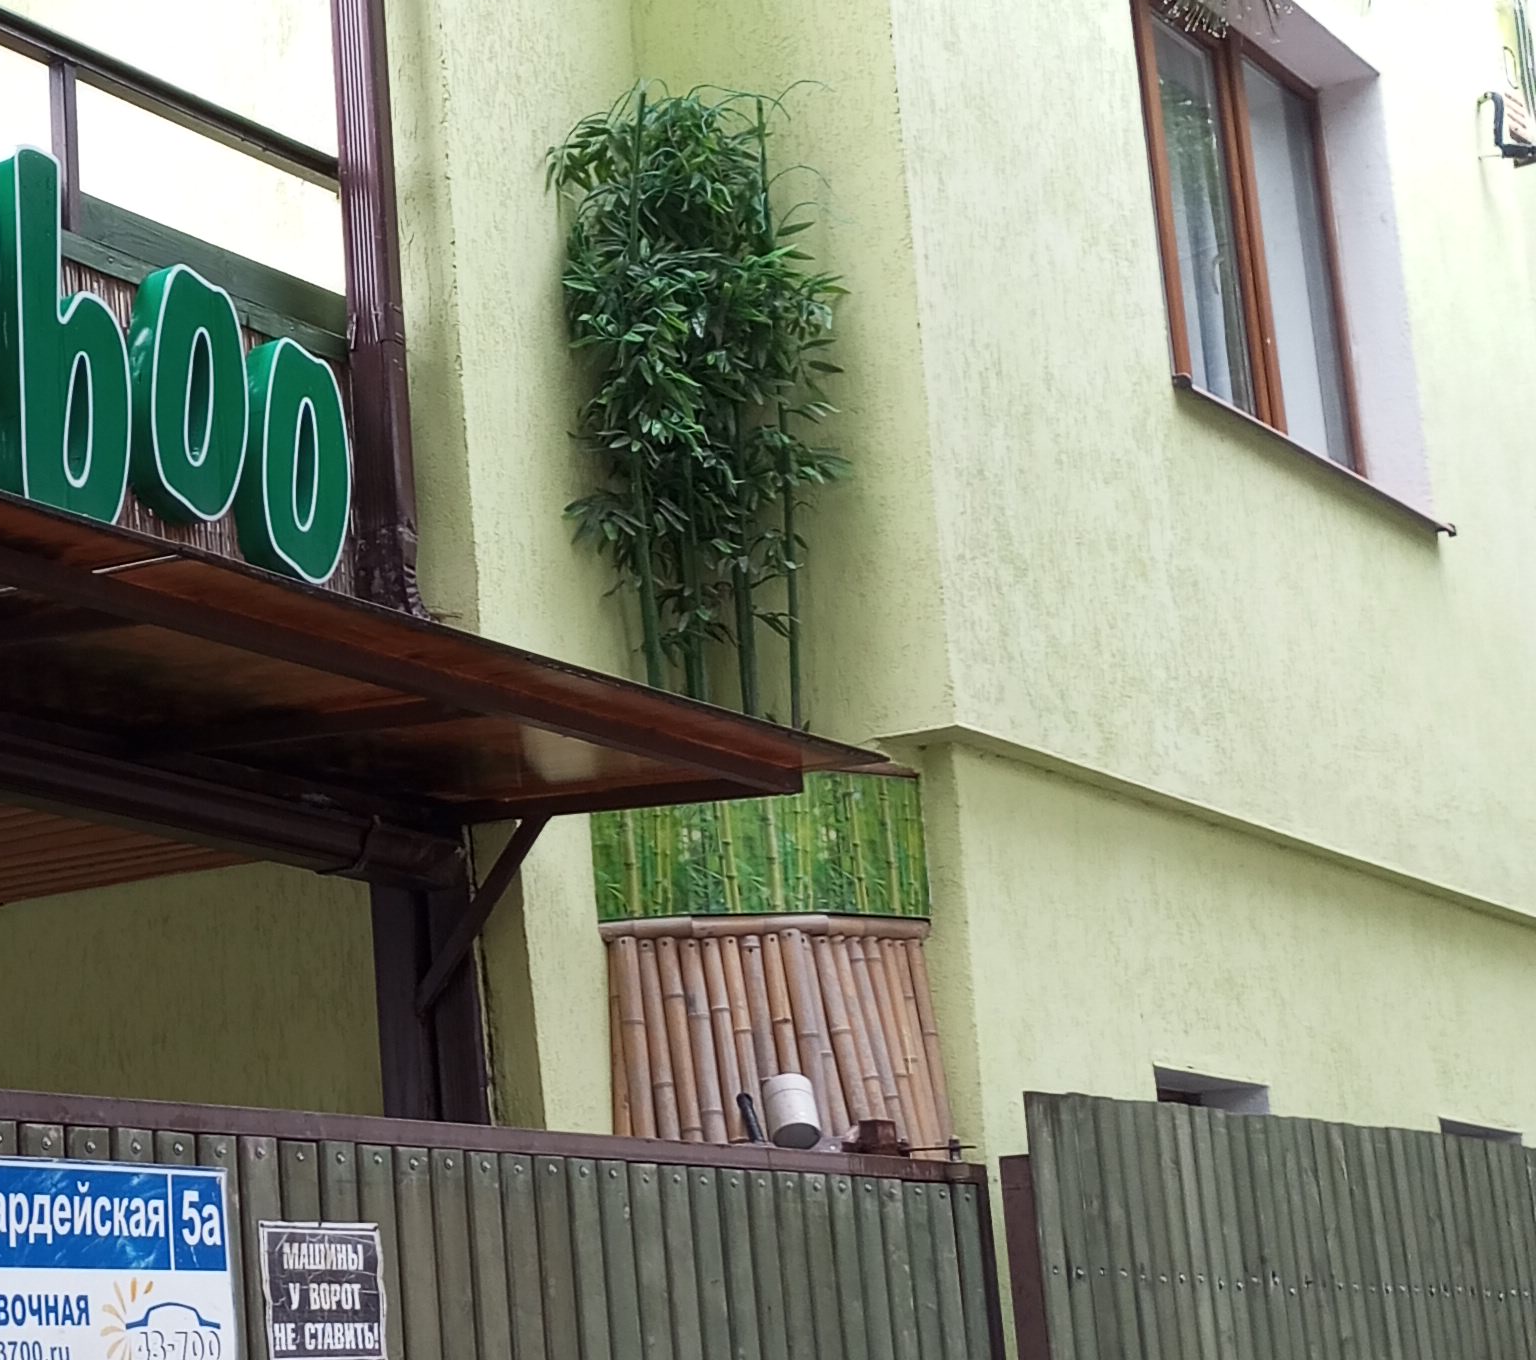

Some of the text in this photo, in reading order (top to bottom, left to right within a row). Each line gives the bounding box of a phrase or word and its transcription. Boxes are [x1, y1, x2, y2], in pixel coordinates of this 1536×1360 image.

[181, 1189, 222, 1246] 5а
[282, 1242, 364, 1270] МАШИНЫ
[288, 1283, 362, 1311] У ВОРОТ
[273, 1322, 380, 1351] НЕ СТАВИТЬ!
